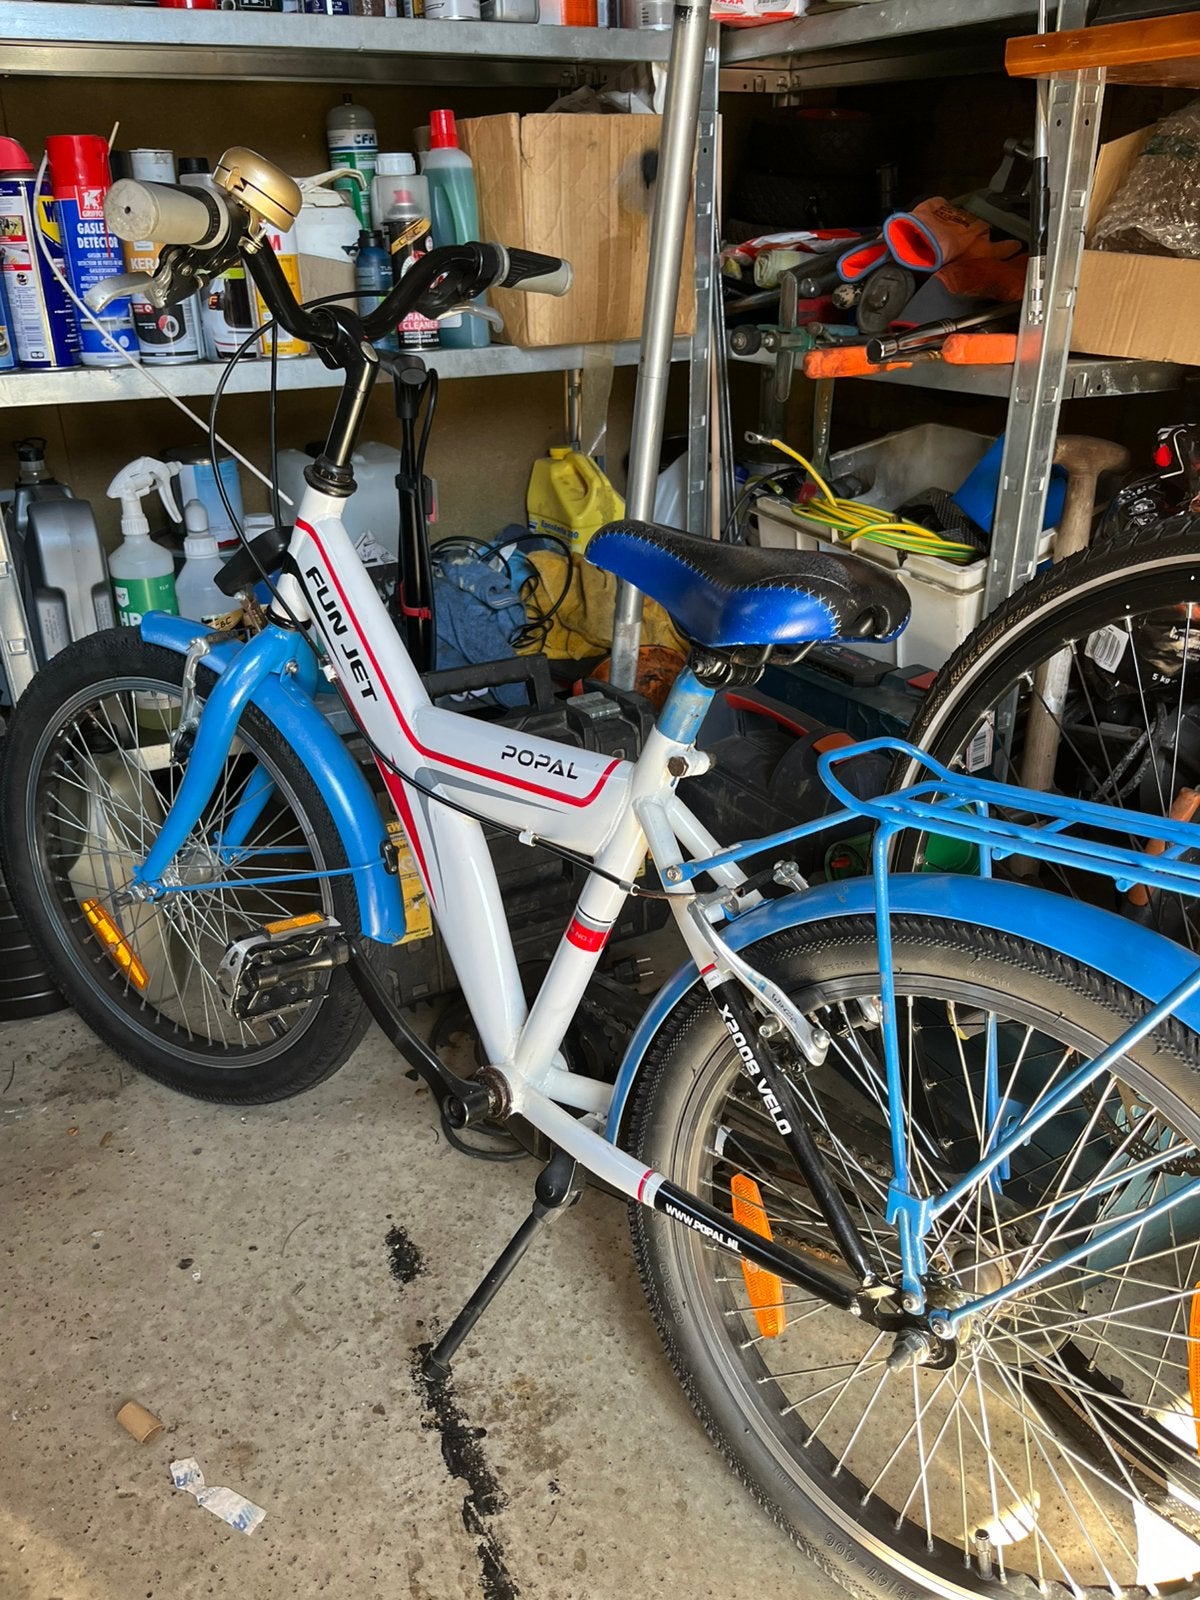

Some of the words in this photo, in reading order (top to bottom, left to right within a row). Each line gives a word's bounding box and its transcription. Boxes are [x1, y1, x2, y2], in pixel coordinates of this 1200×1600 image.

[354, 133, 375, 145] CFH
[77, 236, 119, 249] DETECTOR
[402, 319, 439, 331] CLEANER
[305, 566, 349, 636] FUN
[340, 643, 378, 702] JET
[501, 744, 579, 780] POPAL
[717, 1003, 761, 1076] X2008
[756, 1077, 792, 1136] VELO
[665, 1202, 743, 1254] WWW.POPAL.NL
